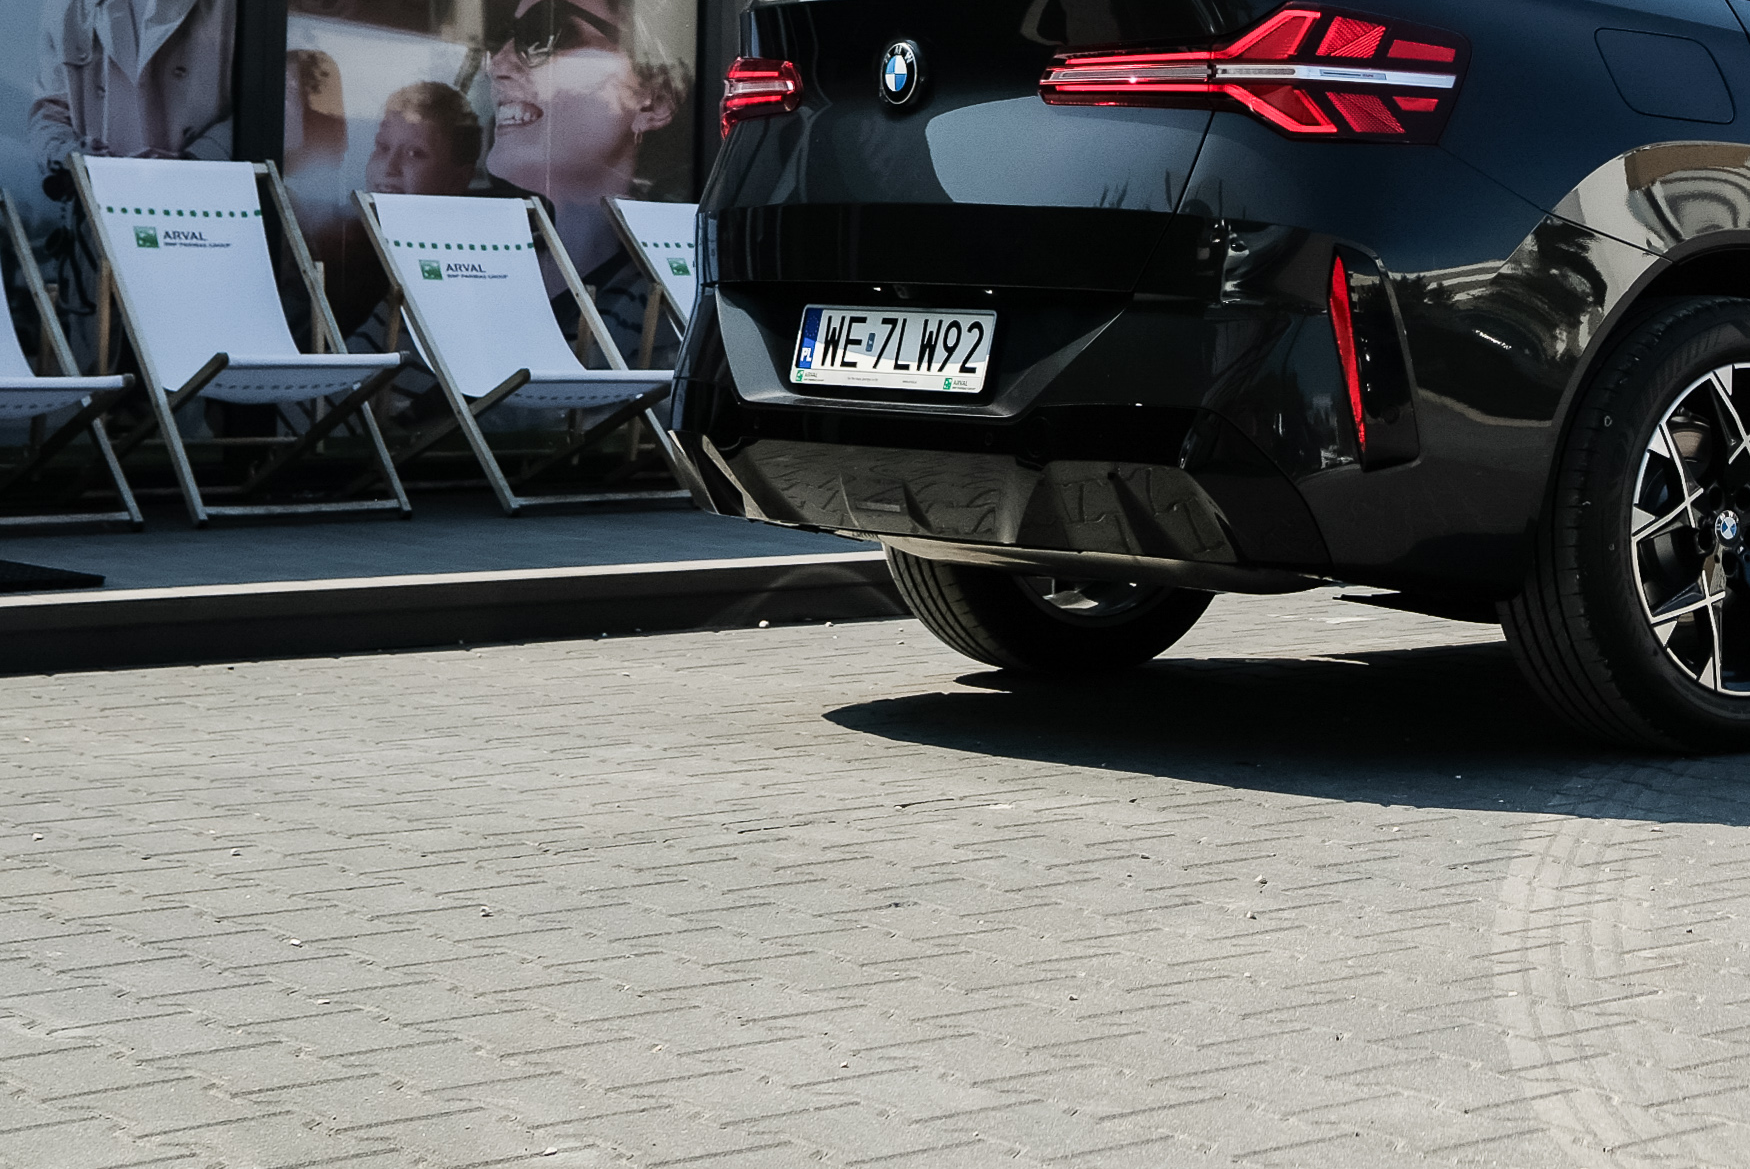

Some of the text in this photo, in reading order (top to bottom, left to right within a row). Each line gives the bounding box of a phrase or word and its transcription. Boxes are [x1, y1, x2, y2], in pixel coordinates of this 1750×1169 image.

[163, 230, 208, 242] ARVAL
[446, 262, 487, 274] ARVAL
[821, 315, 985, 374] WE 7LW92
[800, 347, 813, 362] PL
